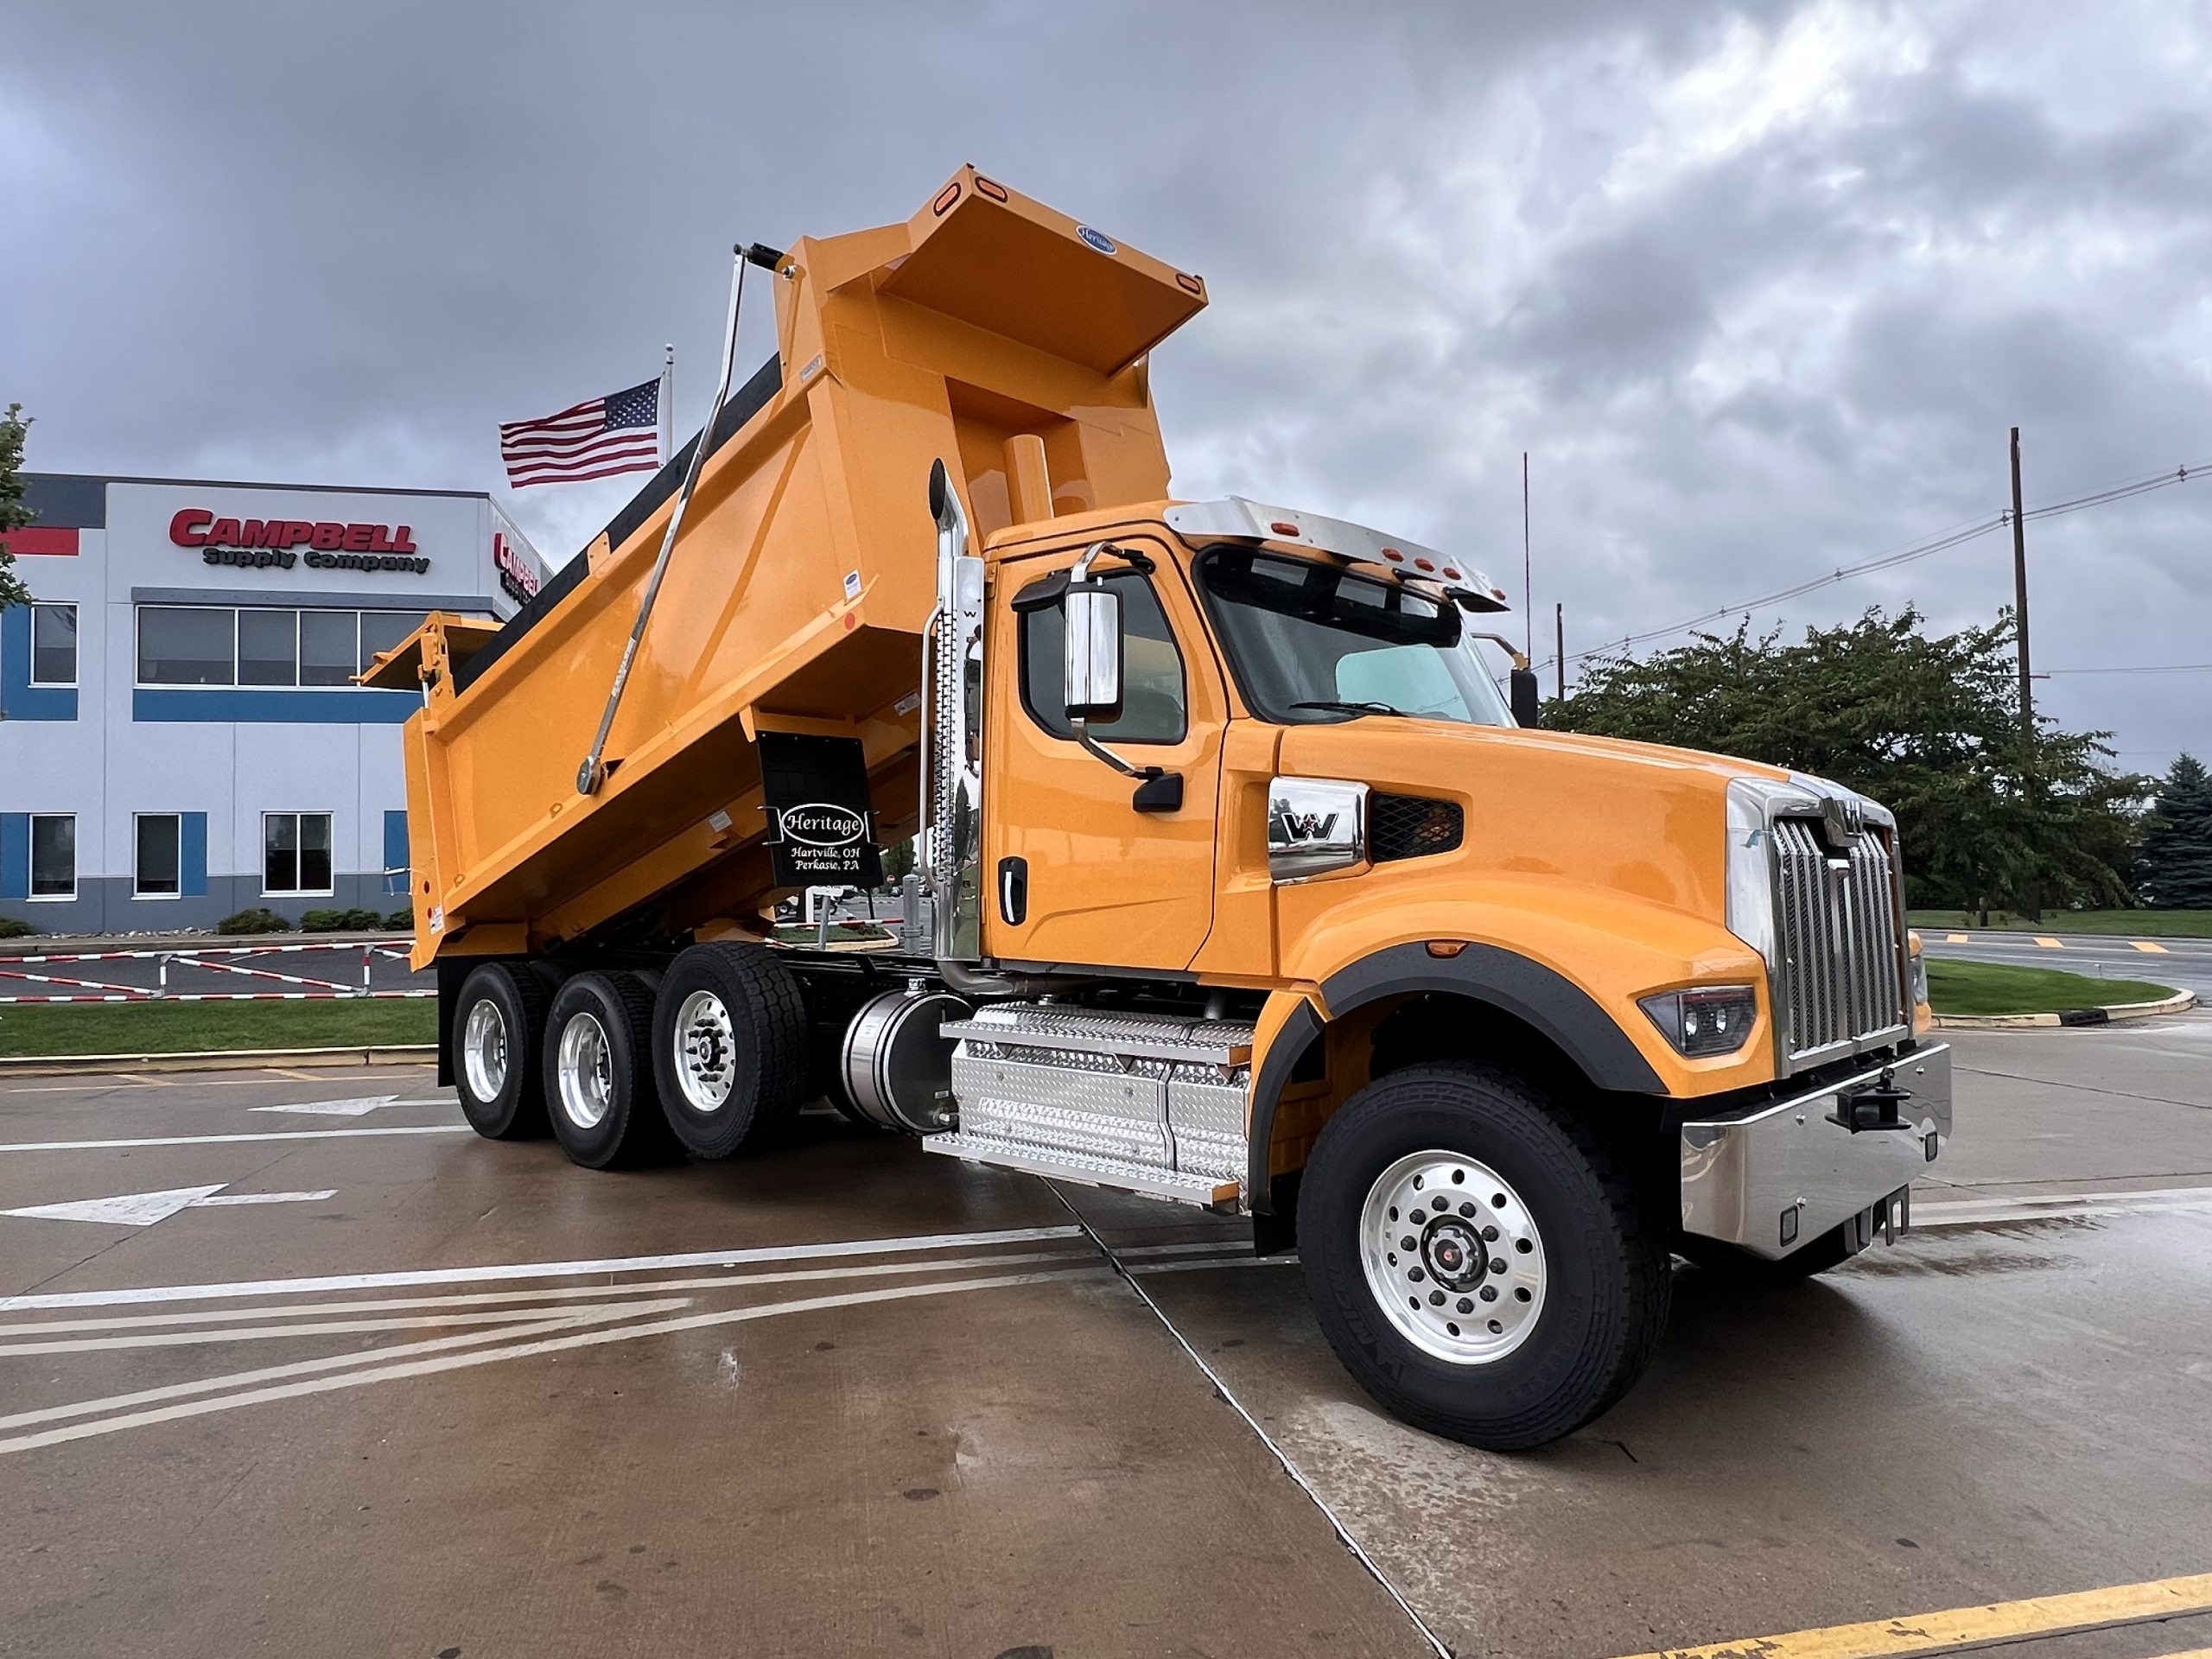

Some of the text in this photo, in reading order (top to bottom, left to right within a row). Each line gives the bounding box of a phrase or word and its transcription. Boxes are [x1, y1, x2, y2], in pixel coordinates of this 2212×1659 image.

[169, 508, 416, 553] CAMPBELL
[202, 547, 430, 574] Supply Company
[786, 812, 861, 836] Heritage
[791, 847, 861, 859] Hartville, OH
[842, 860, 860, 870] PA
